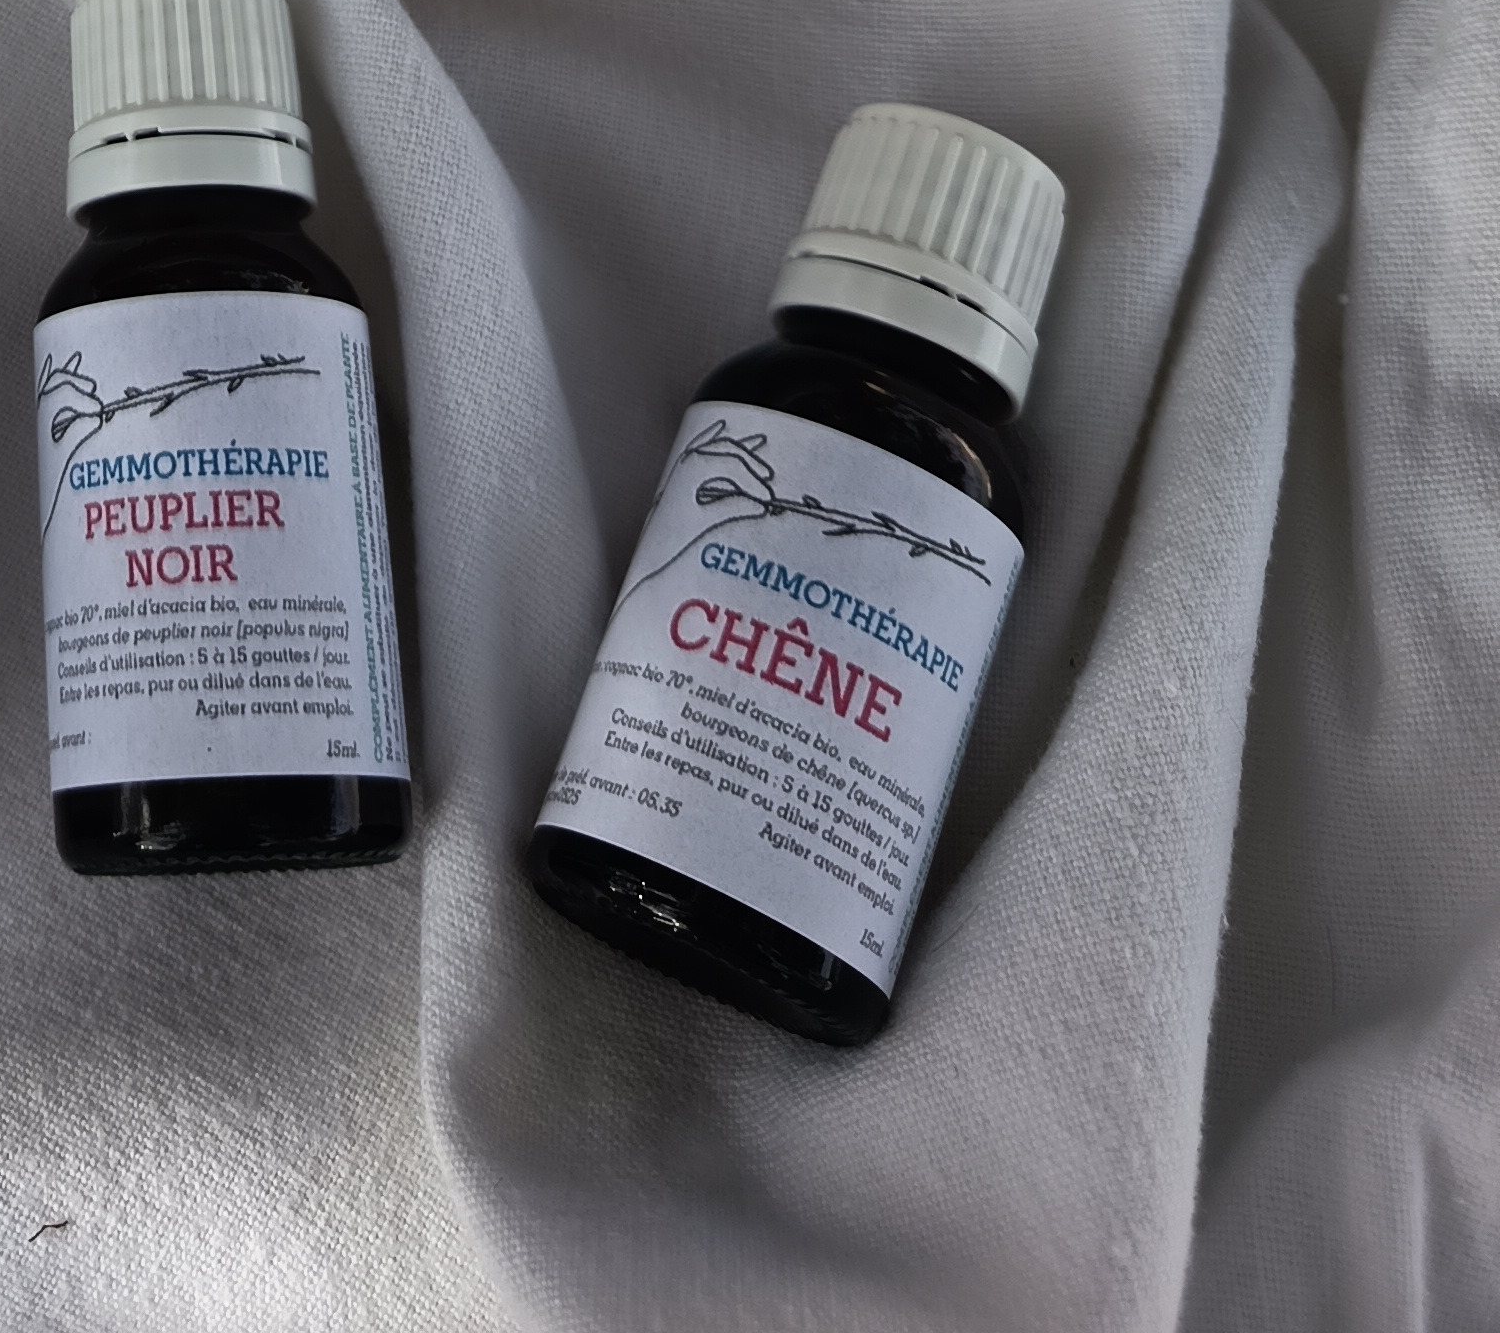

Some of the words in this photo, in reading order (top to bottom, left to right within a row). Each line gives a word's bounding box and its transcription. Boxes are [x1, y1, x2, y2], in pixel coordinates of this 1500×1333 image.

[69, 439, 330, 490] GEMMOTHÉRAPIE
[83, 488, 285, 541] PEUPLIER
[125, 544, 238, 589] NOIR
[137, 595, 206, 618] d'acacia
[700, 543, 964, 691] GEMMOTHÉRAPIE
[99, 650, 185, 672] d'utilisation
[251, 647, 311, 668] gouttes
[133, 621, 196, 646] peuplier
[200, 621, 233, 639] noir
[249, 670, 291, 689] dans
[670, 598, 903, 742] CHÊNE
[196, 698, 246, 720] Agiter
[250, 698, 299, 715] avant
[695, 685, 736, 709] miel
[735, 698, 810, 745] d'acacia
[611, 707, 669, 739] Conseils
[671, 727, 769, 784] d'utilisation
[681, 702, 770, 753] bourgeons
[797, 756, 846, 791] chêne
[604, 730, 639, 754] Entre
[717, 777, 750, 800] pur
[751, 793, 774, 812] ou
[776, 802, 820, 834] dilué
[821, 825, 860, 859] dans
[758, 821, 811, 860] Agiter
[813, 854, 857, 888] avant
